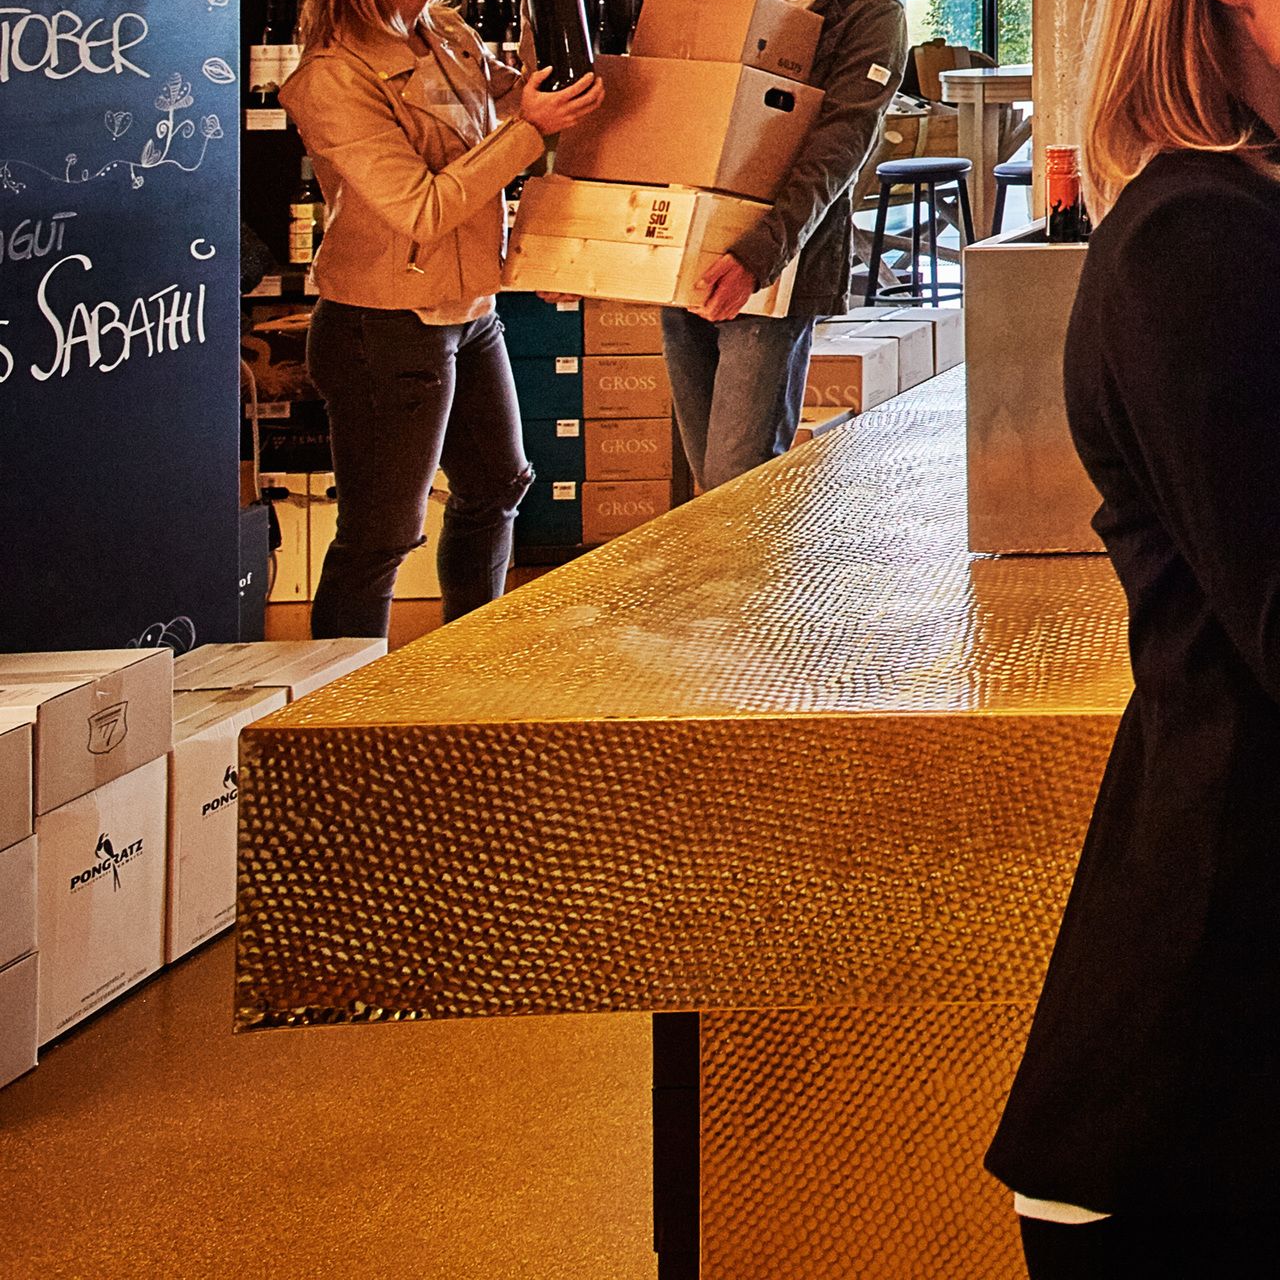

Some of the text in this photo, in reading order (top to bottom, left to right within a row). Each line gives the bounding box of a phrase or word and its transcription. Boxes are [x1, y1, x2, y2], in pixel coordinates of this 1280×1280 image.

[0, 7, 150, 83] TOBER
[652, 200, 671, 213] LOI
[649, 213, 667, 226] SIU
[600, 312, 657, 327] GROSS
[600, 376, 657, 391] GROSS
[601, 439, 658, 454] GROSS
[599, 501, 656, 516] GROSS
[202, 788, 238, 816] PONG
